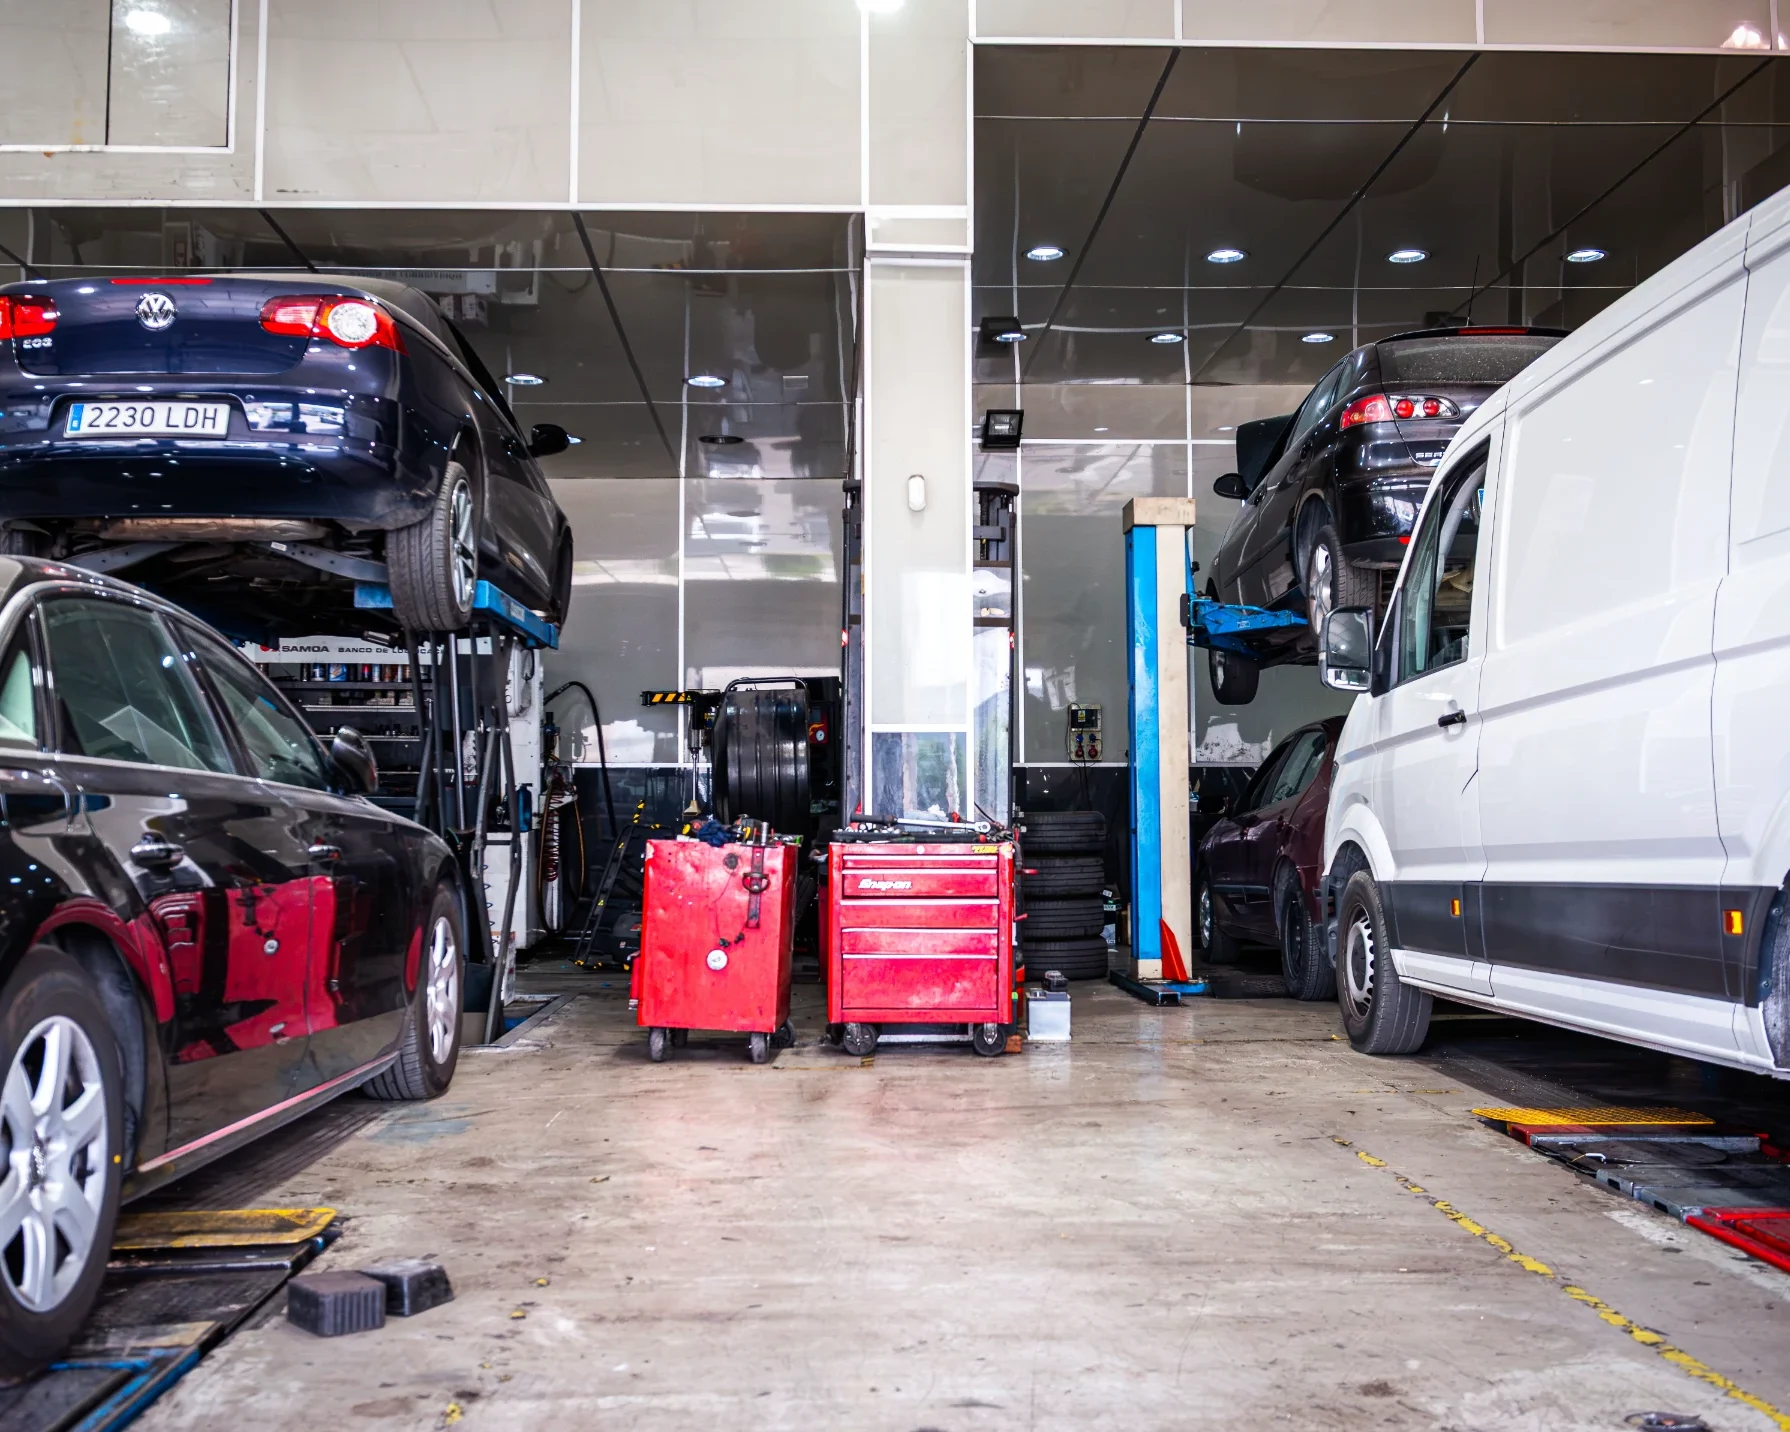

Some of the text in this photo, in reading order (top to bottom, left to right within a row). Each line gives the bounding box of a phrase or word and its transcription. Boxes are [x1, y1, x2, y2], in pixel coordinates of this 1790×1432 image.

[87, 406, 155, 428] 2230
[166, 406, 218, 429] LDH
[281, 645, 330, 653] SAMOA
